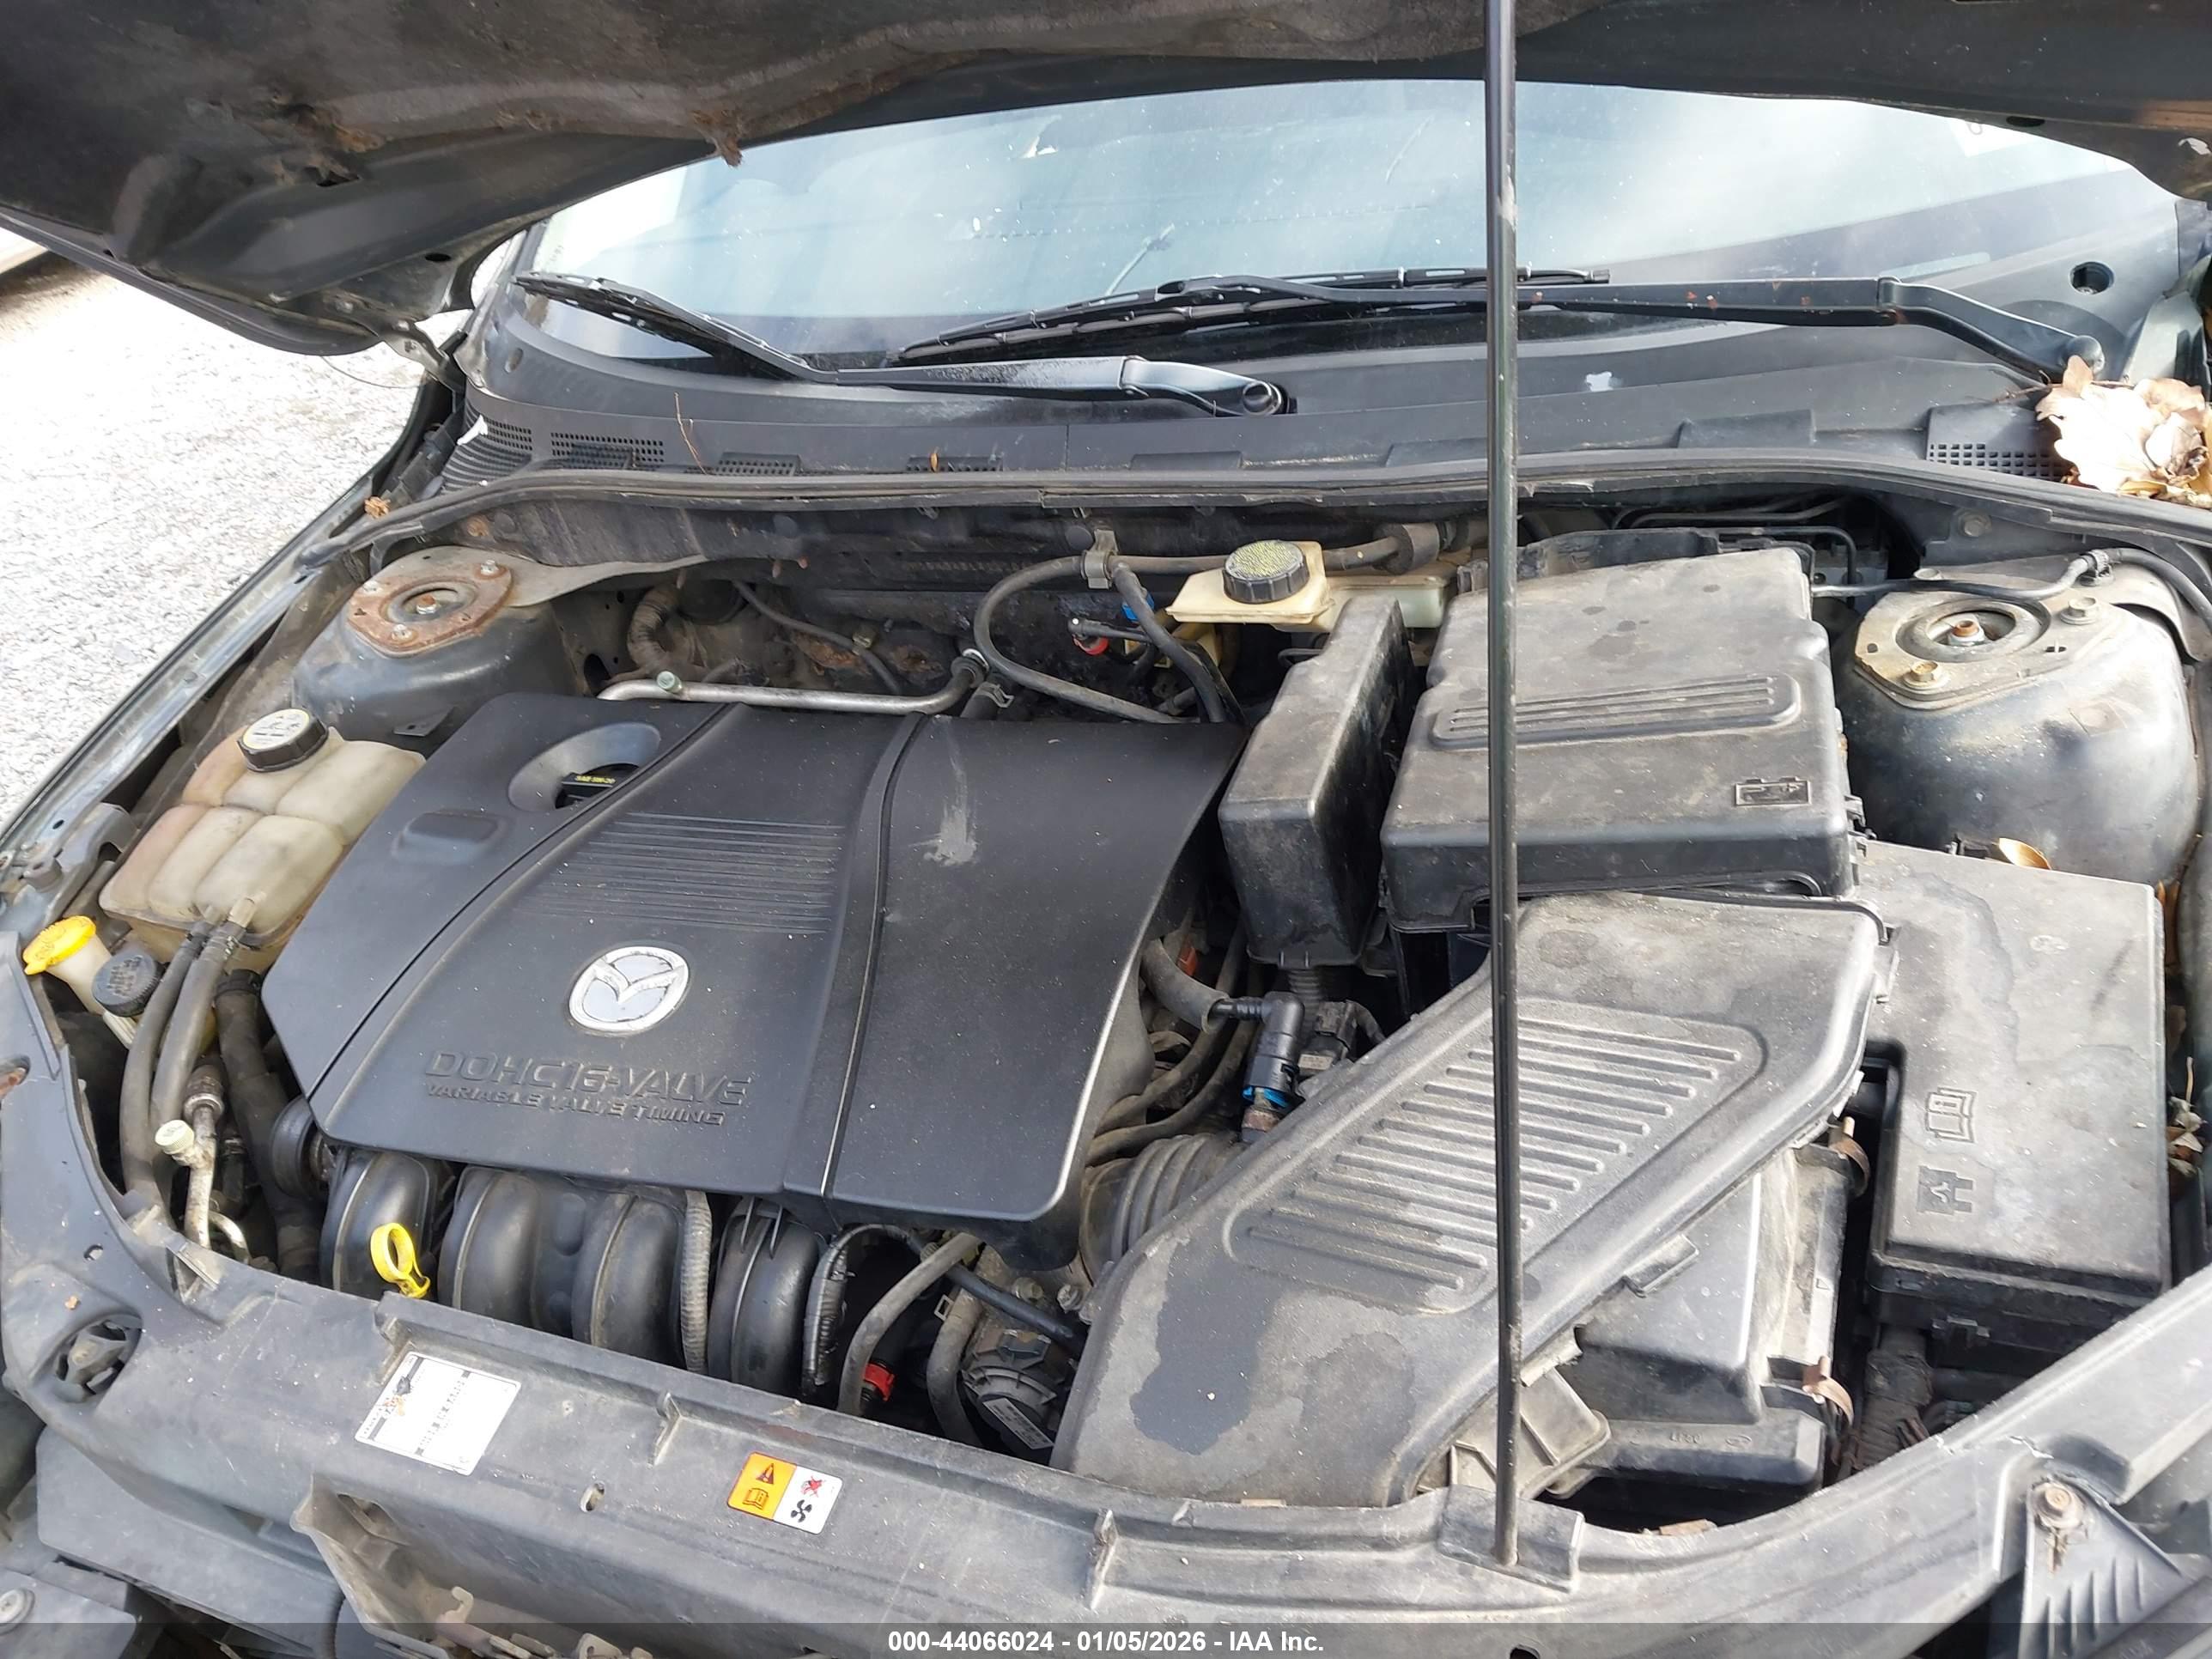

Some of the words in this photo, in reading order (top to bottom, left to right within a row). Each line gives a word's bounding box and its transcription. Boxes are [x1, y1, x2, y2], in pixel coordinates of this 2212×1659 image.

[425, 1049, 566, 1089] DOHC
[426, 1080, 543, 1109] VARIABLE
[548, 1093, 626, 1118] VALVE
[627, 1101, 726, 1126] TIMING
